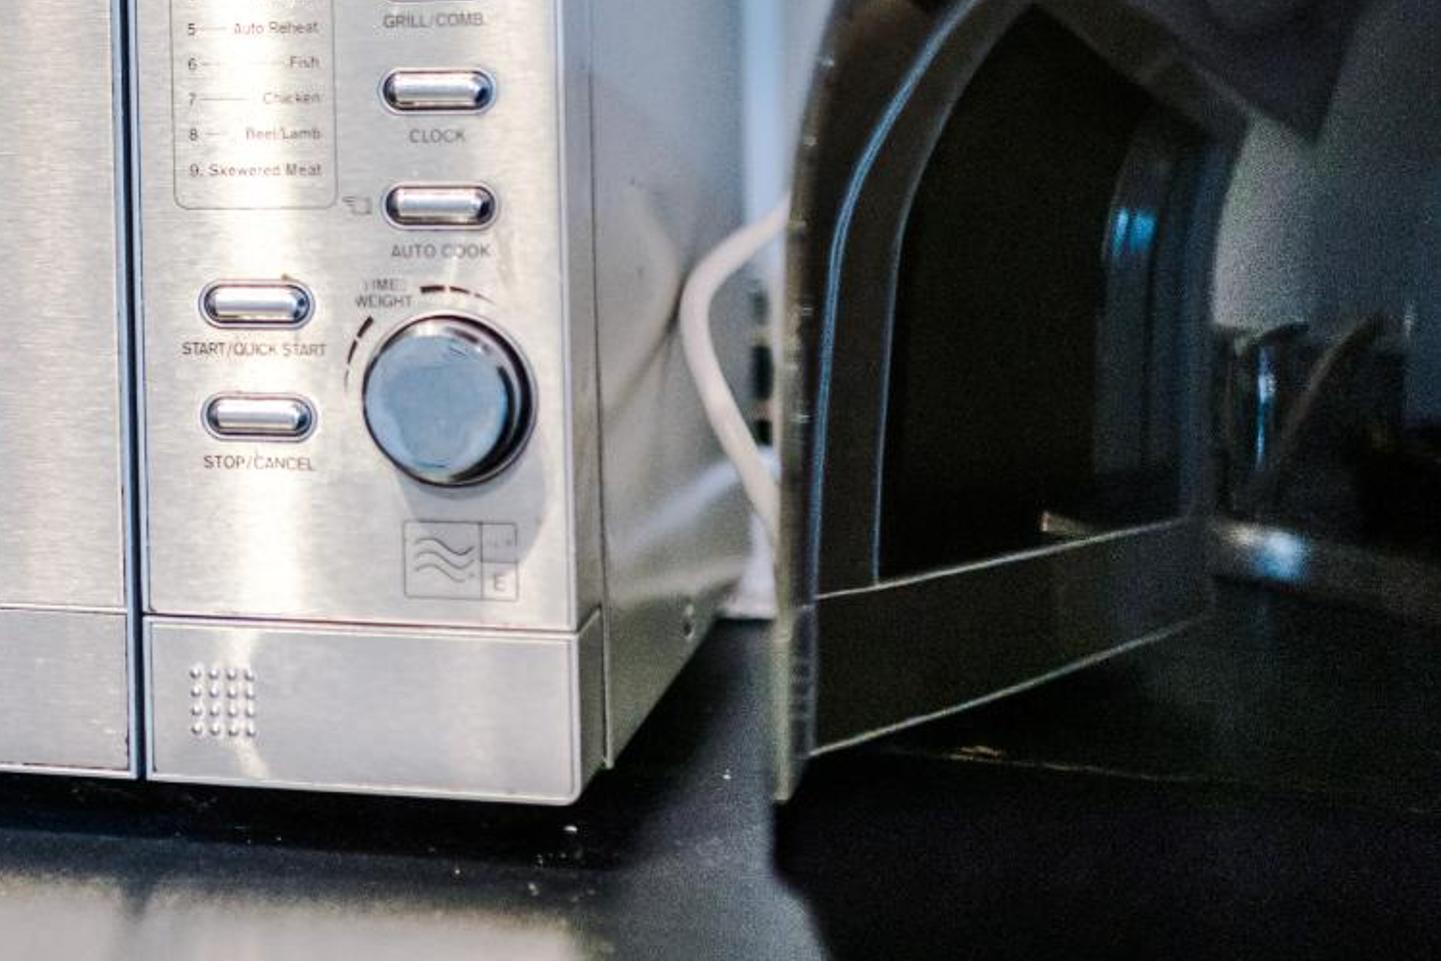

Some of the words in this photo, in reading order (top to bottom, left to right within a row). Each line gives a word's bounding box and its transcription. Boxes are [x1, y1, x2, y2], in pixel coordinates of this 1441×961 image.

[187, 22, 197, 37] 5
[233, 22, 264, 35] Auto
[268, 20, 319, 35] Reheat
[187, 57, 198, 71] 6
[289, 55, 321, 69] Fish
[189, 93, 197, 106] 7
[263, 91, 321, 105] Chicken
[189, 128, 199, 142] 8
[409, 128, 467, 143] CLOCK
[209, 163, 281, 178] Skewered
[285, 162, 323, 178] Meat
[390, 244, 436, 259] AUTO
[442, 243, 492, 258] COOK
[354, 294, 412, 309] WEIGHT
[182, 341, 277, 357] START/QUICK
[283, 343, 328, 357] START
[203, 455, 315, 472] STOP/CANCEL
